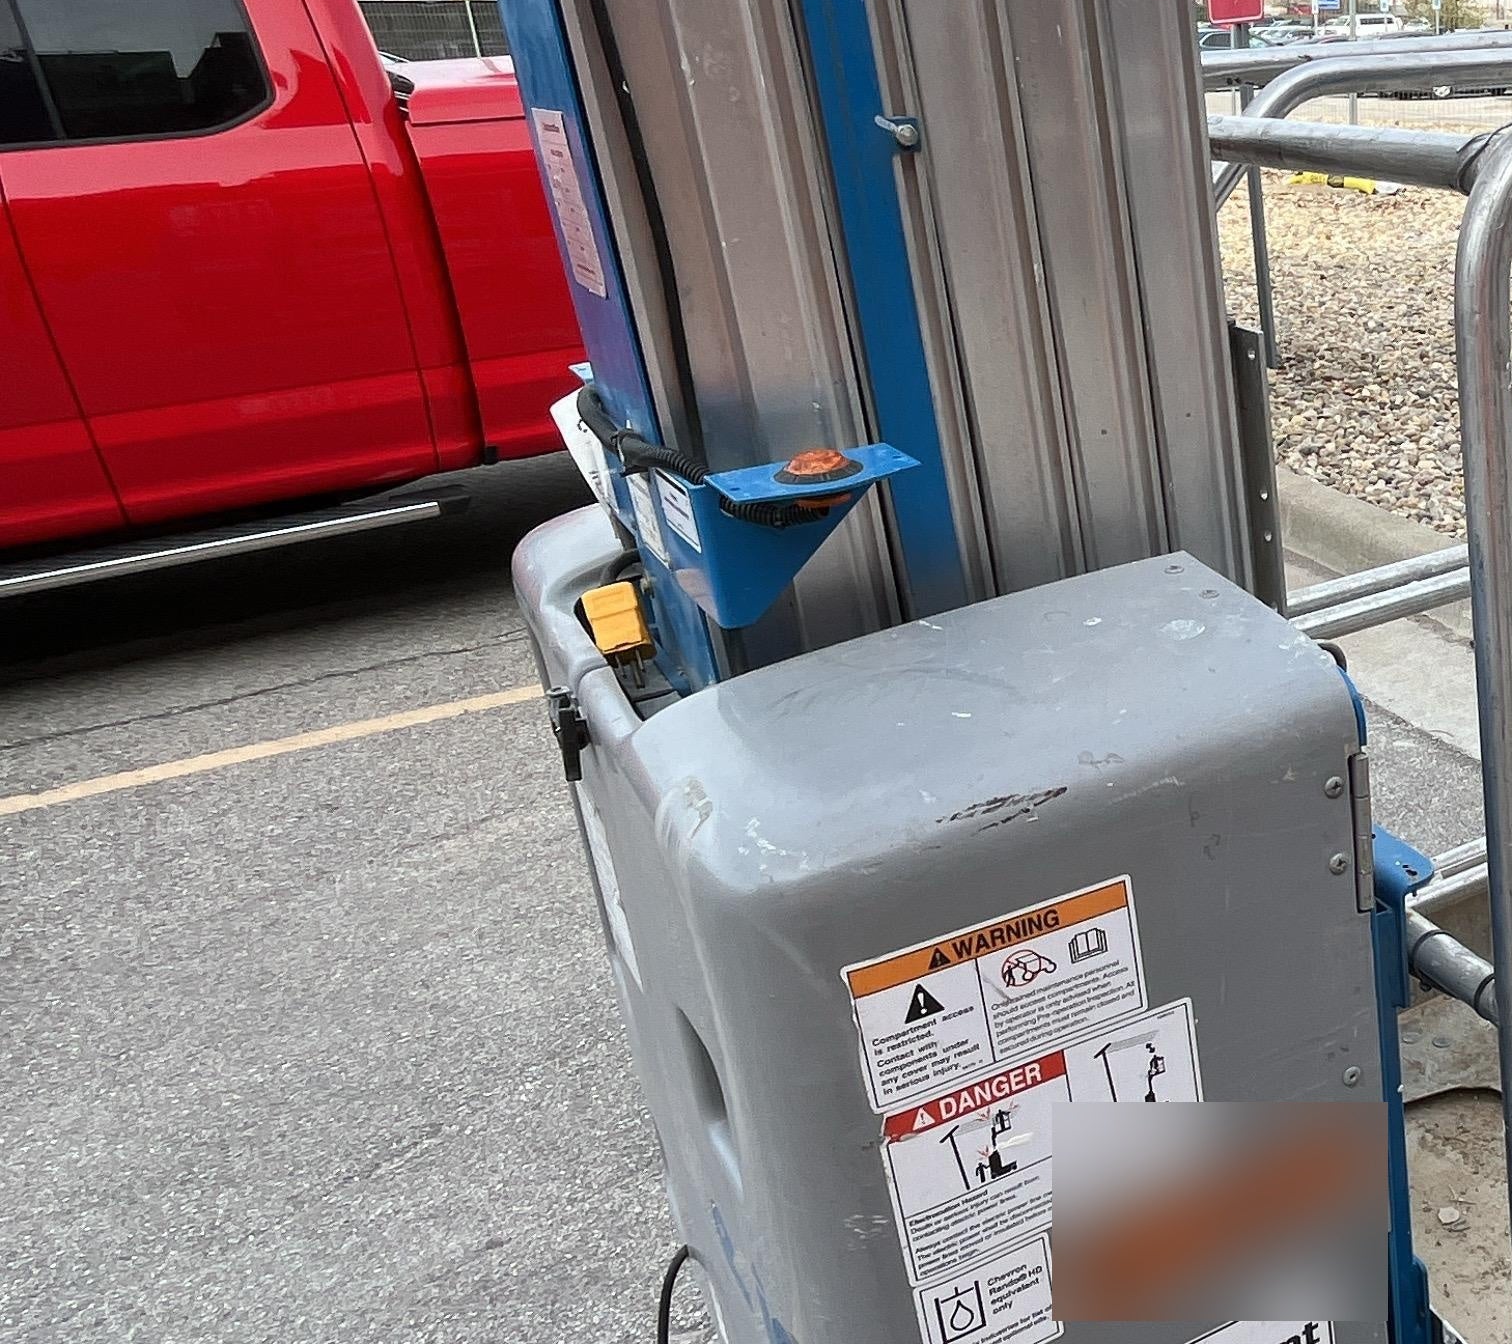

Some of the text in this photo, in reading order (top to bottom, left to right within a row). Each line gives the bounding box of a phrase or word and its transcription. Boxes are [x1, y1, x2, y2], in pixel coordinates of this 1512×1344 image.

[952, 909, 1061, 960] WARNING
[872, 1006, 974, 1046] Compartment access
[877, 1041, 937, 1067] Contact with
[887, 1030, 934, 1052] restricted.
[879, 1039, 968, 1076] components under
[881, 1076, 898, 1086] any
[902, 1065, 927, 1079] cover
[932, 1056, 950, 1067] may
[954, 1044, 979, 1058] result
[896, 1074, 929, 1091] serious
[933, 1063, 959, 1076] injury.
[940, 1063, 1043, 1118] DANGER
[987, 1264, 1027, 1286] Chevron
[1028, 1266, 1042, 1277] HD
[991, 1277, 1039, 1305] equivalent
[993, 1301, 1012, 1314] only
